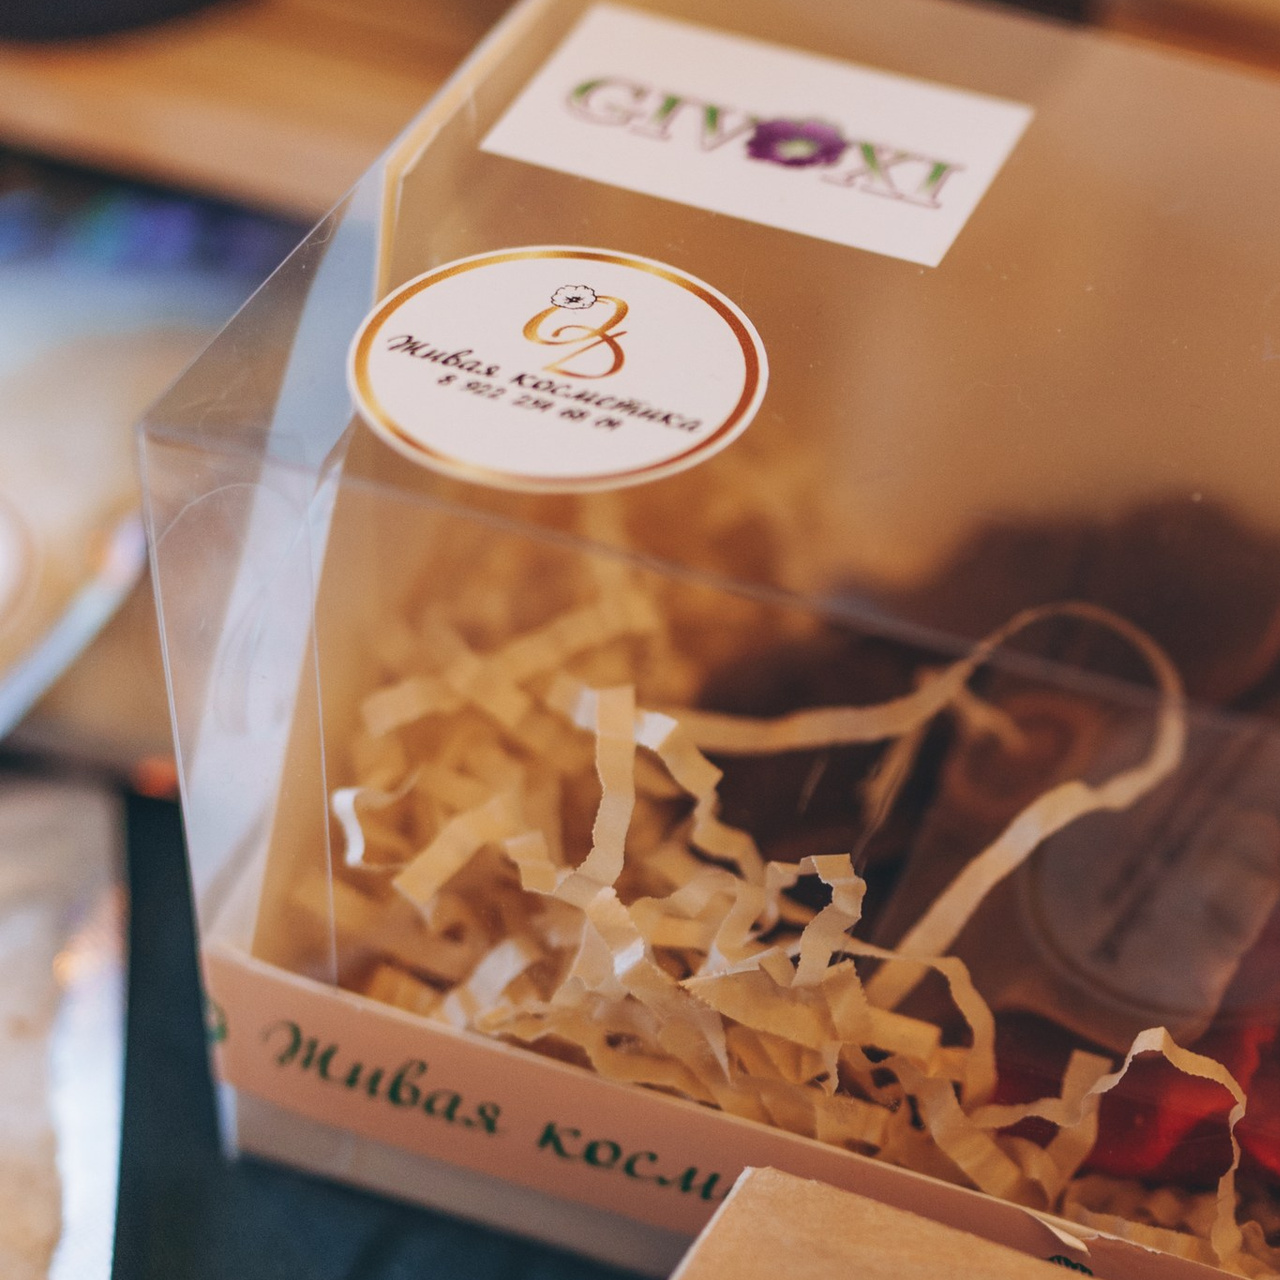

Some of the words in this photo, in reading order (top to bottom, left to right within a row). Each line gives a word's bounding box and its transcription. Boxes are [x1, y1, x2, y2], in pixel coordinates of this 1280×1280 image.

[387, 333, 500, 379] Живая
[510, 371, 702, 434] косметика
[264, 1020, 504, 1137] Живая
[537, 1120, 734, 1202] косм
